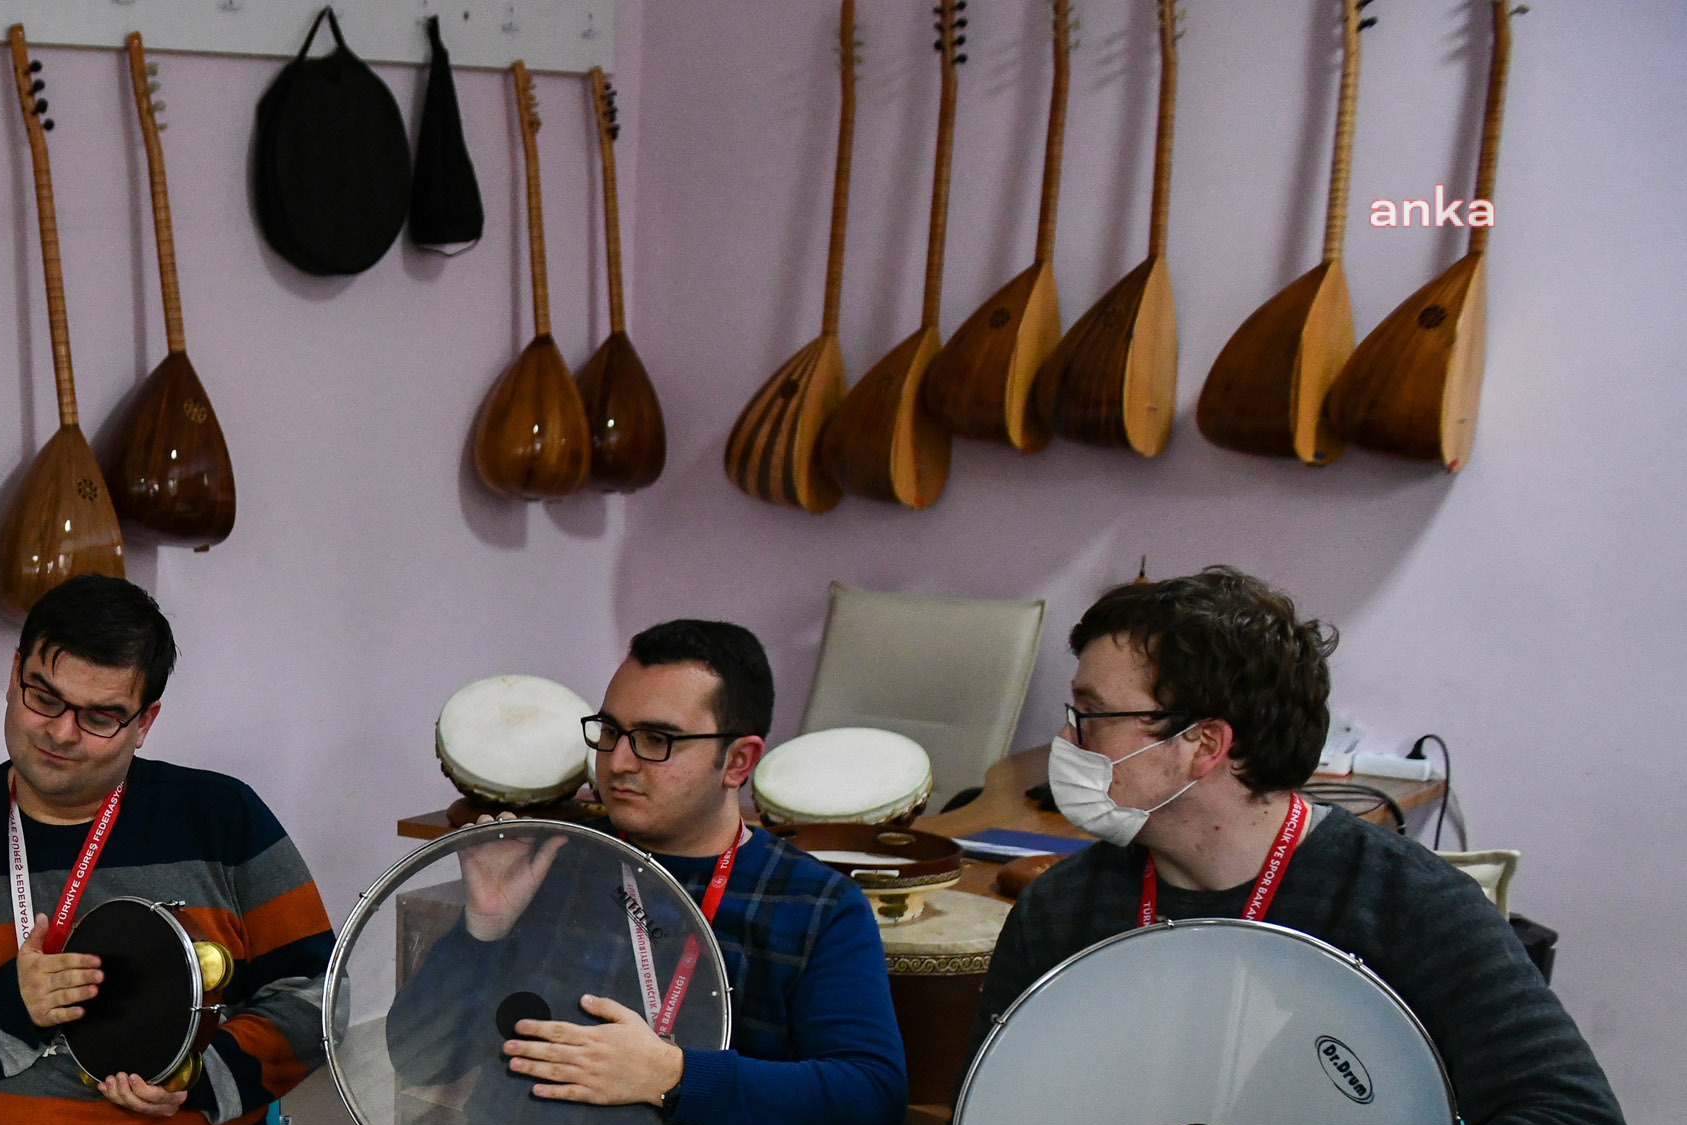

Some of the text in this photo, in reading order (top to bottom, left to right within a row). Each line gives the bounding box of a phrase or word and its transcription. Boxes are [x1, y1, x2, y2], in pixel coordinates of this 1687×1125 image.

[56, 780, 124, 926] TÜRKİYE GÜREŞ FEDERASYO
[1273, 845, 1287, 859] VE
[1263, 859, 1281, 885] SPOR
[1322, 1044, 1367, 1097] Dr.Drum
